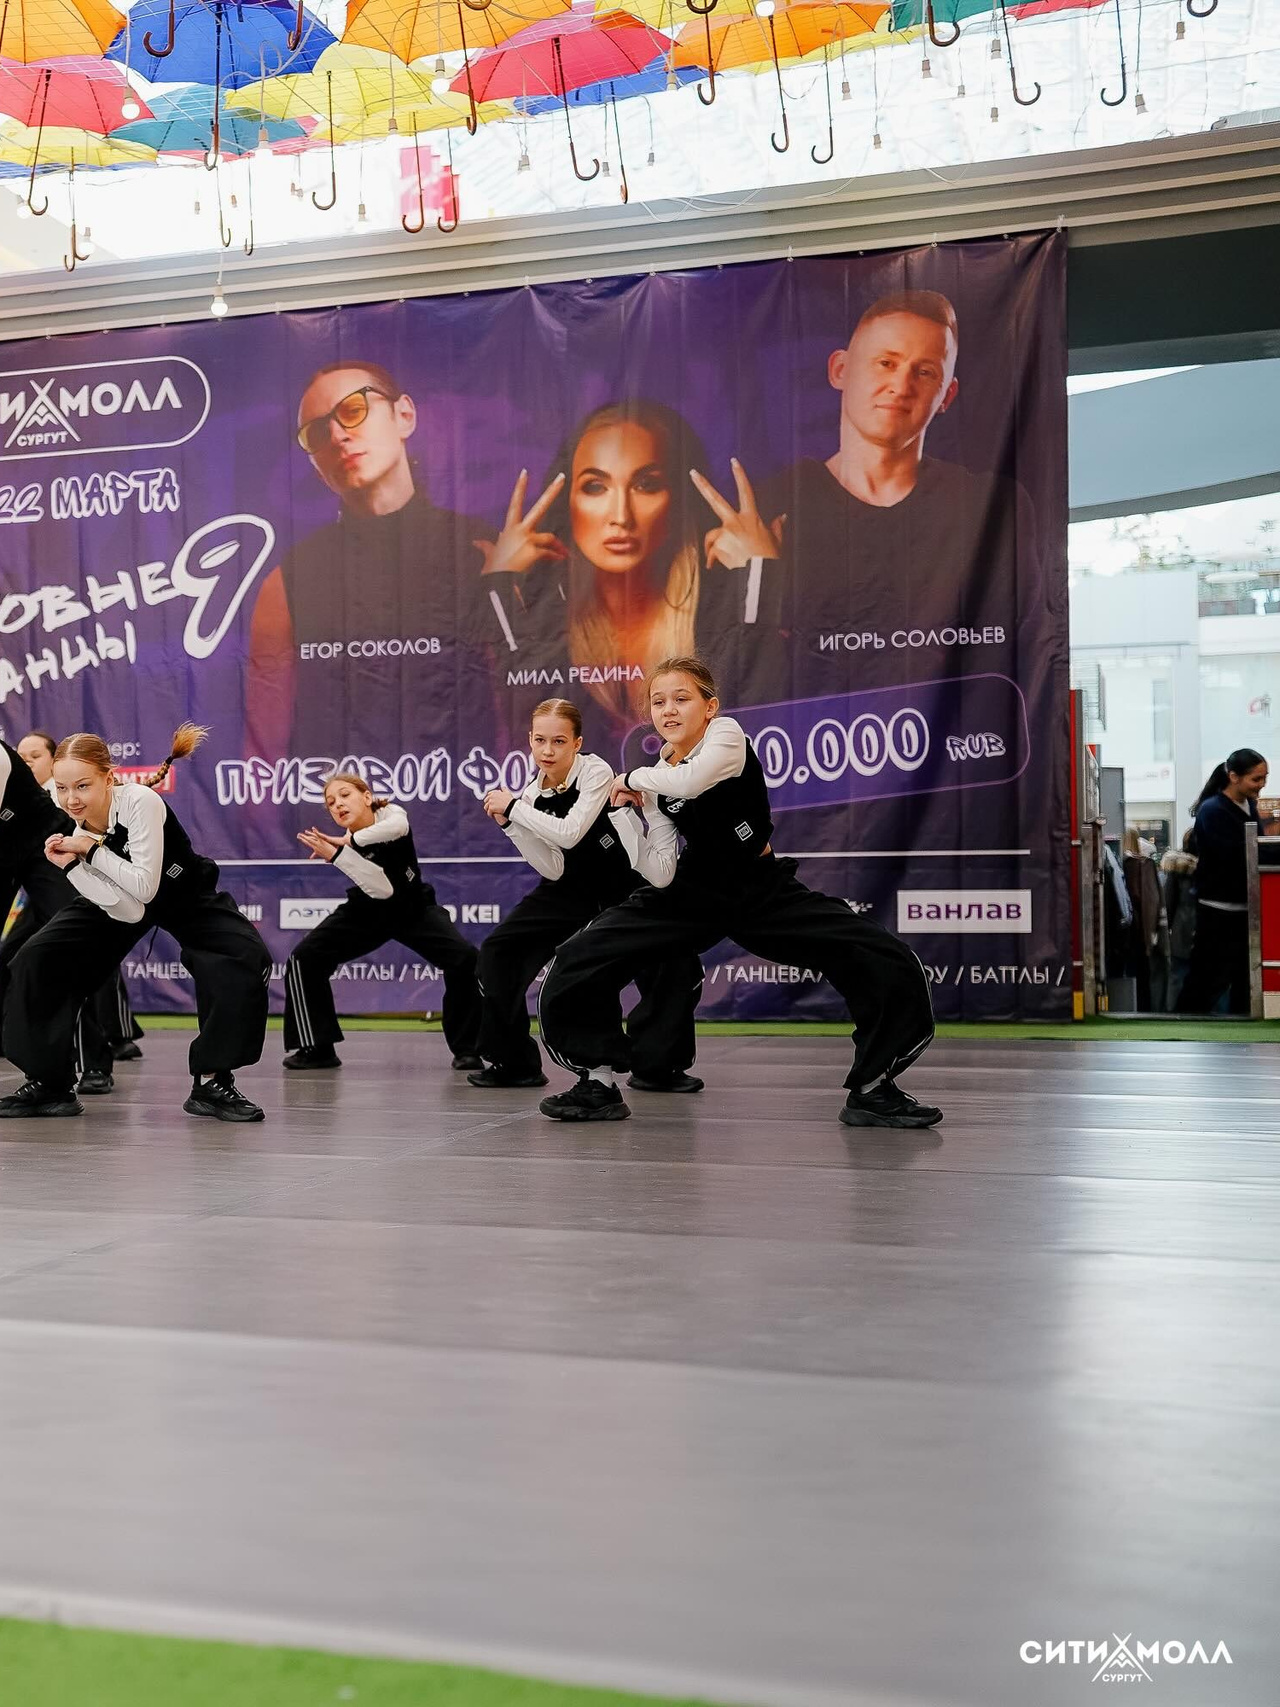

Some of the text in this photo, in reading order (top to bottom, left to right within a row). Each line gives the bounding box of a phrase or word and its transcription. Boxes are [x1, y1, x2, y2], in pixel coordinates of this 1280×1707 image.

[17, 430, 68, 447] СУРГУТ
[50, 467, 181, 521] МАРТА
[300, 637, 441, 660] ЕГОР СОКОЛОВ
[820, 625, 1006, 651] ИГОРЬ СОЛОВЬЕВ
[506, 664, 645, 687] МИЛА РЕДИНА
[744, 707, 1007, 789] 0.000 RUB
[457, 746, 541, 801] ФО
[907, 903, 1023, 921] ванлав
[971, 965, 1050, 984] БАТТЛЫ
